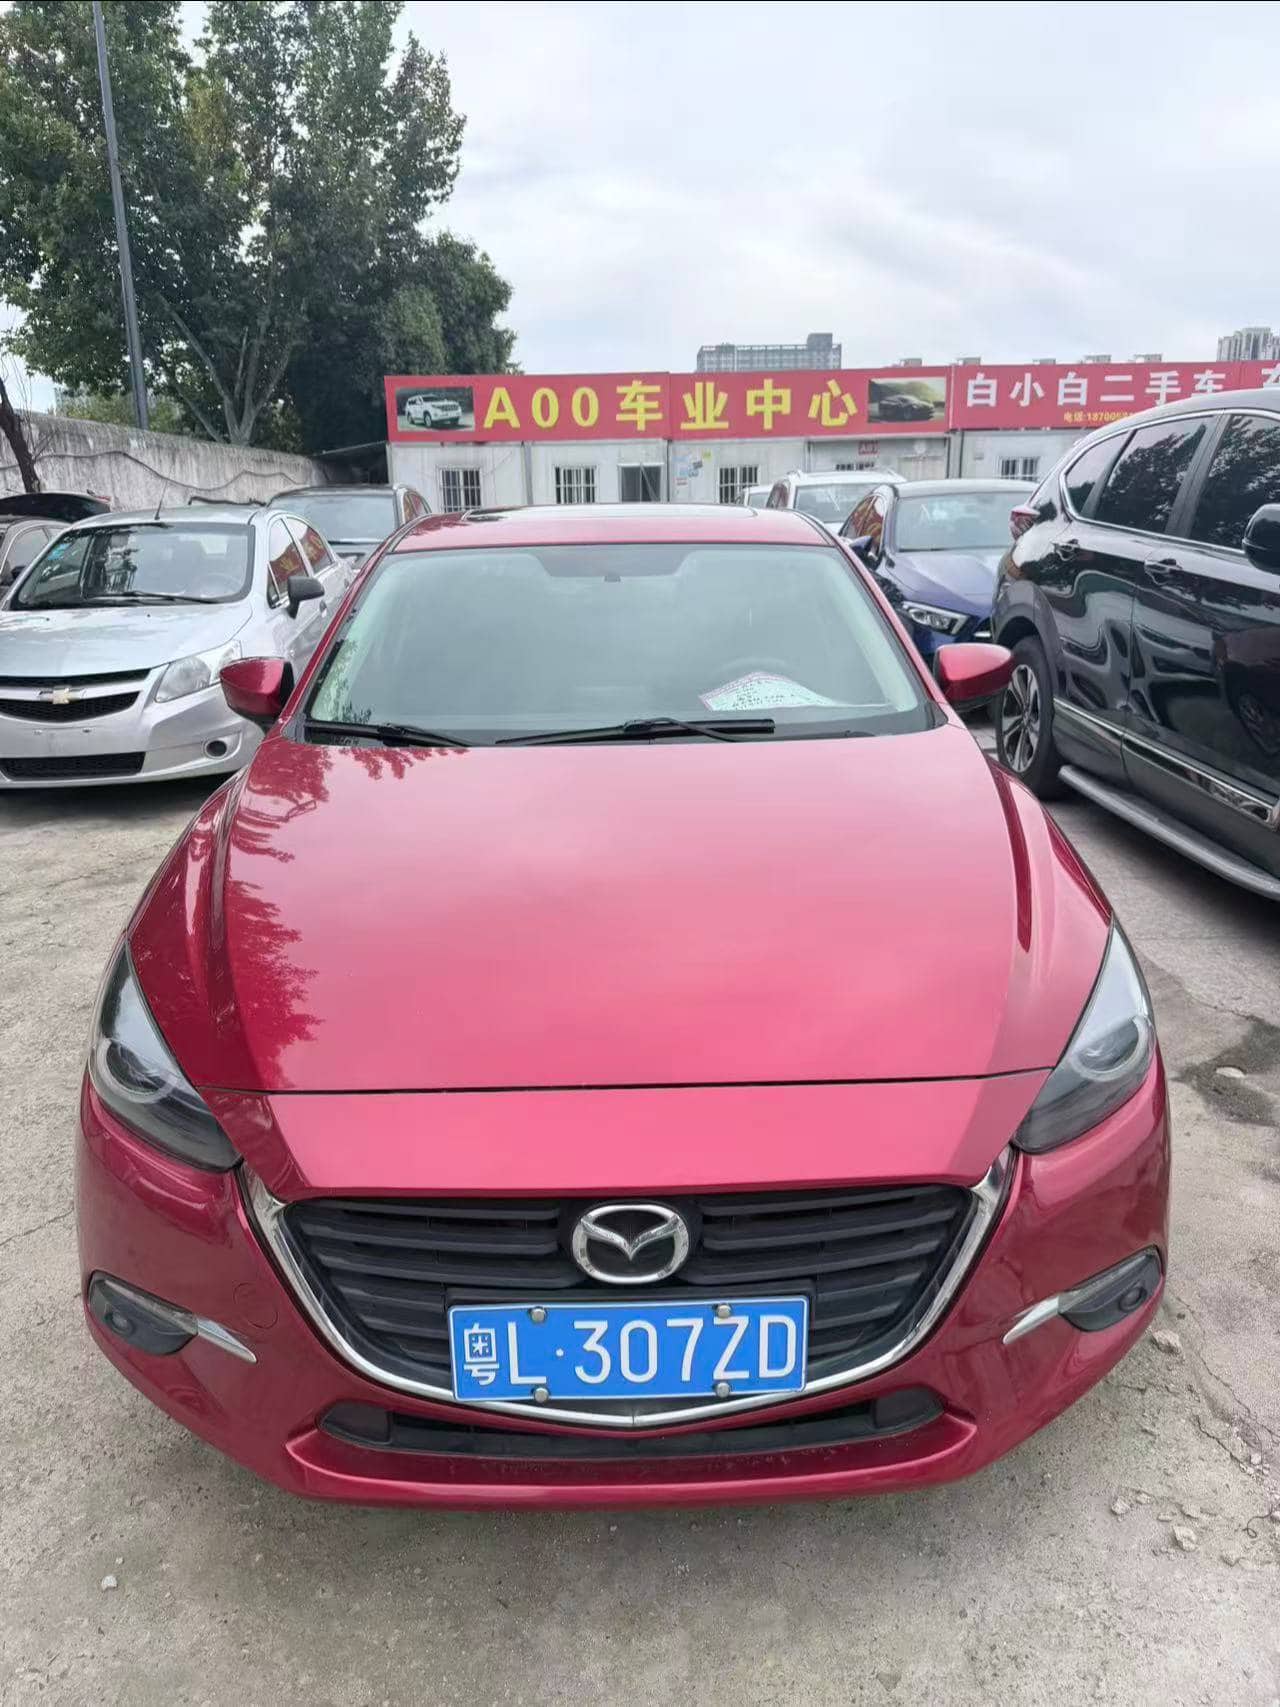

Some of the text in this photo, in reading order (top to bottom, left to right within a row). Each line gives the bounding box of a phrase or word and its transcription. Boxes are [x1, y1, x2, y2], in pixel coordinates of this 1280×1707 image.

[483, 378, 857, 431] A00车业中心
[967, 369, 1226, 407] 白小白二手车
[463, 1315, 797, 1386] 粤L·307ZD
